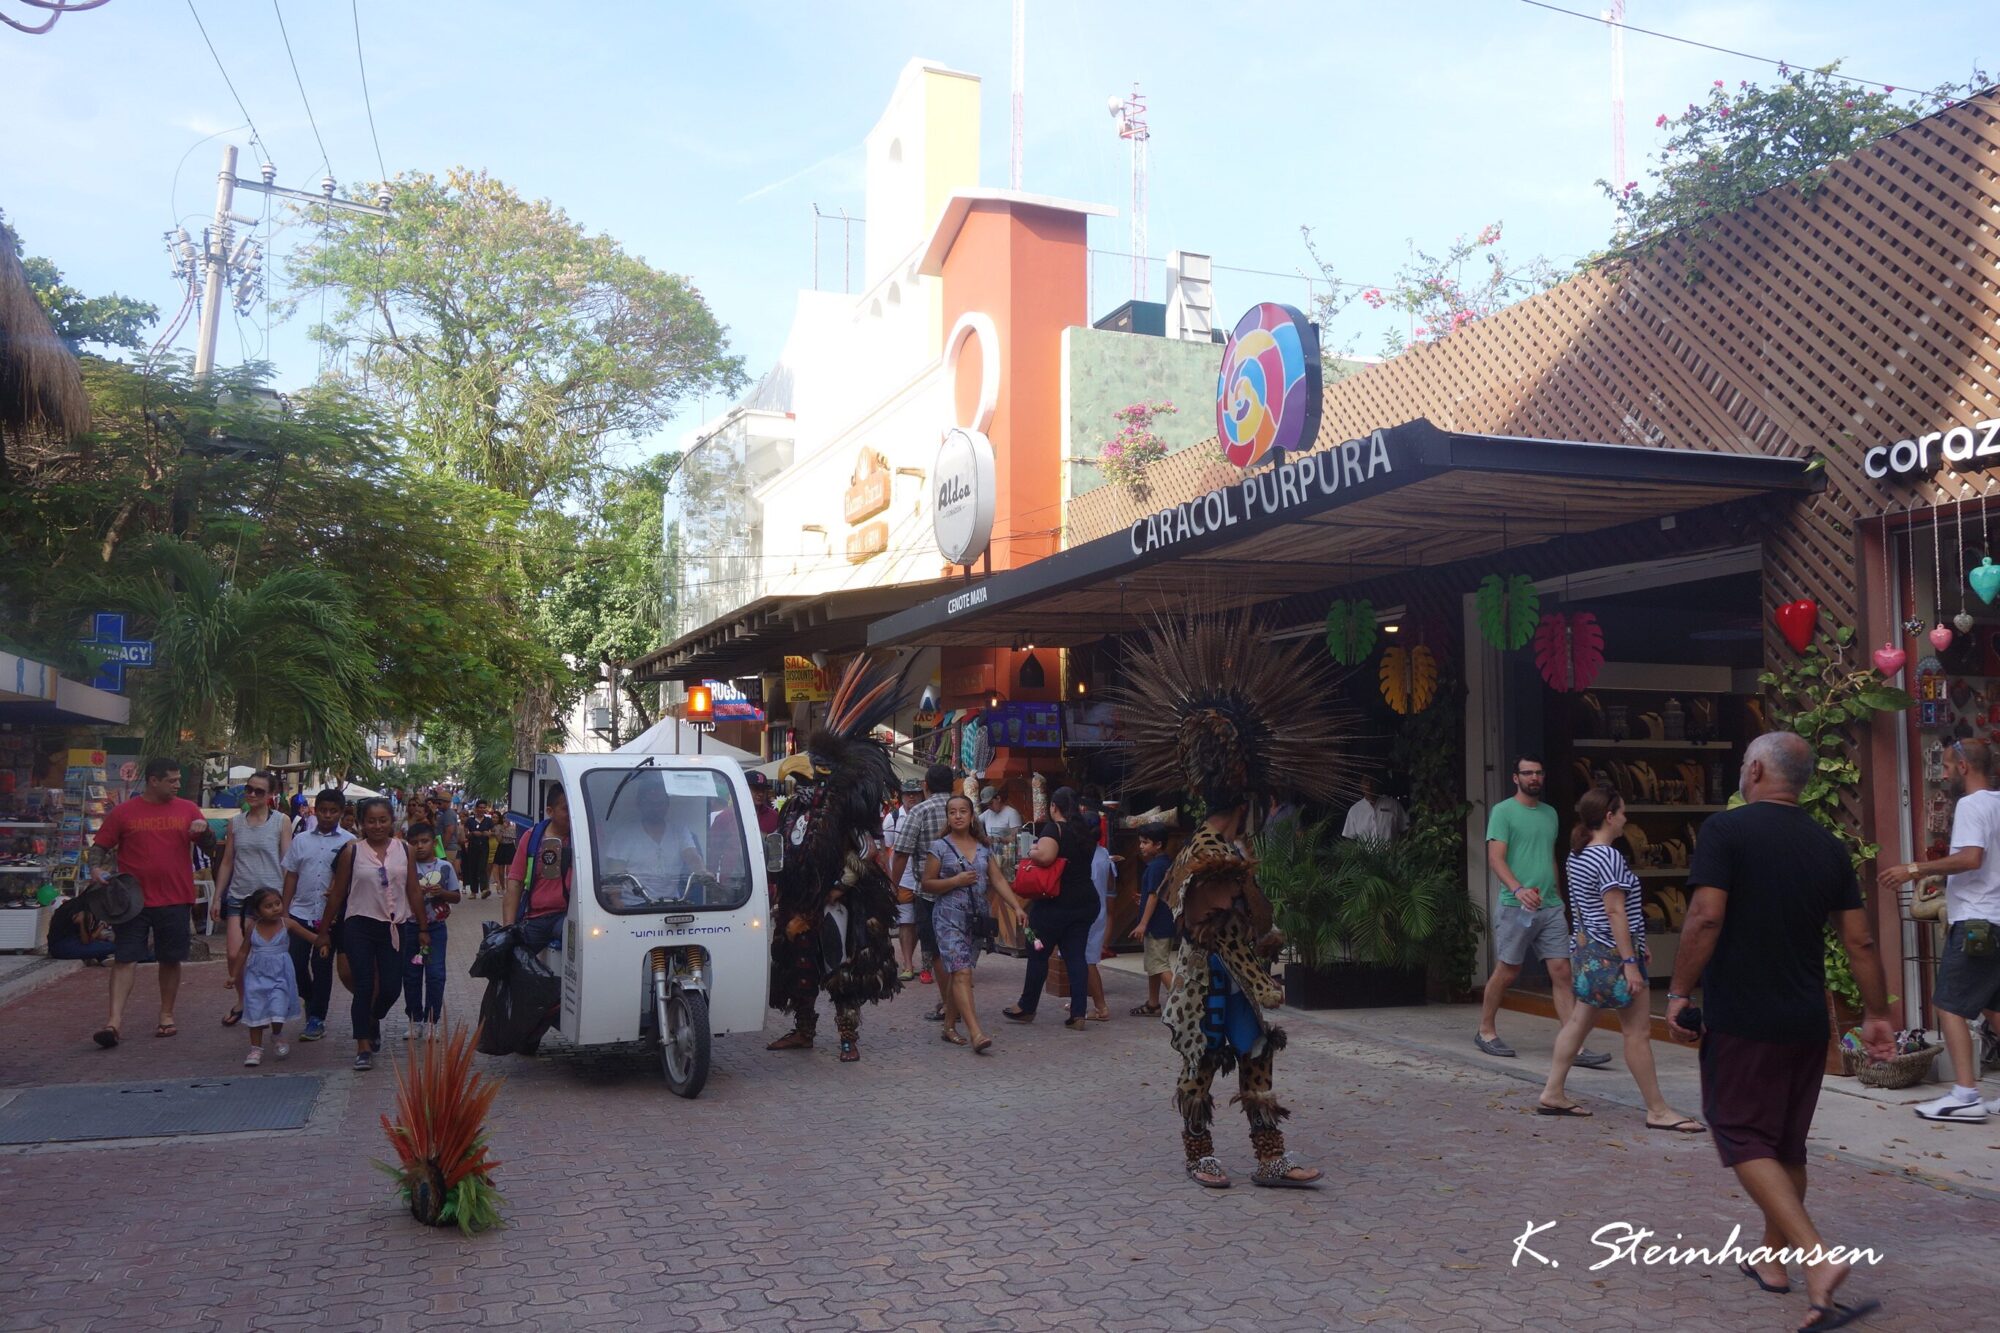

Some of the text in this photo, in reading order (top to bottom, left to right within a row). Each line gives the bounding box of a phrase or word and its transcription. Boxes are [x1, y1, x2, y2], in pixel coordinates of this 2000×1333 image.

[938, 474, 971, 511] Aldea
[1130, 429, 1393, 556] CARACOL PURPURA
[947, 586, 988, 614] CENOTE MAYA
